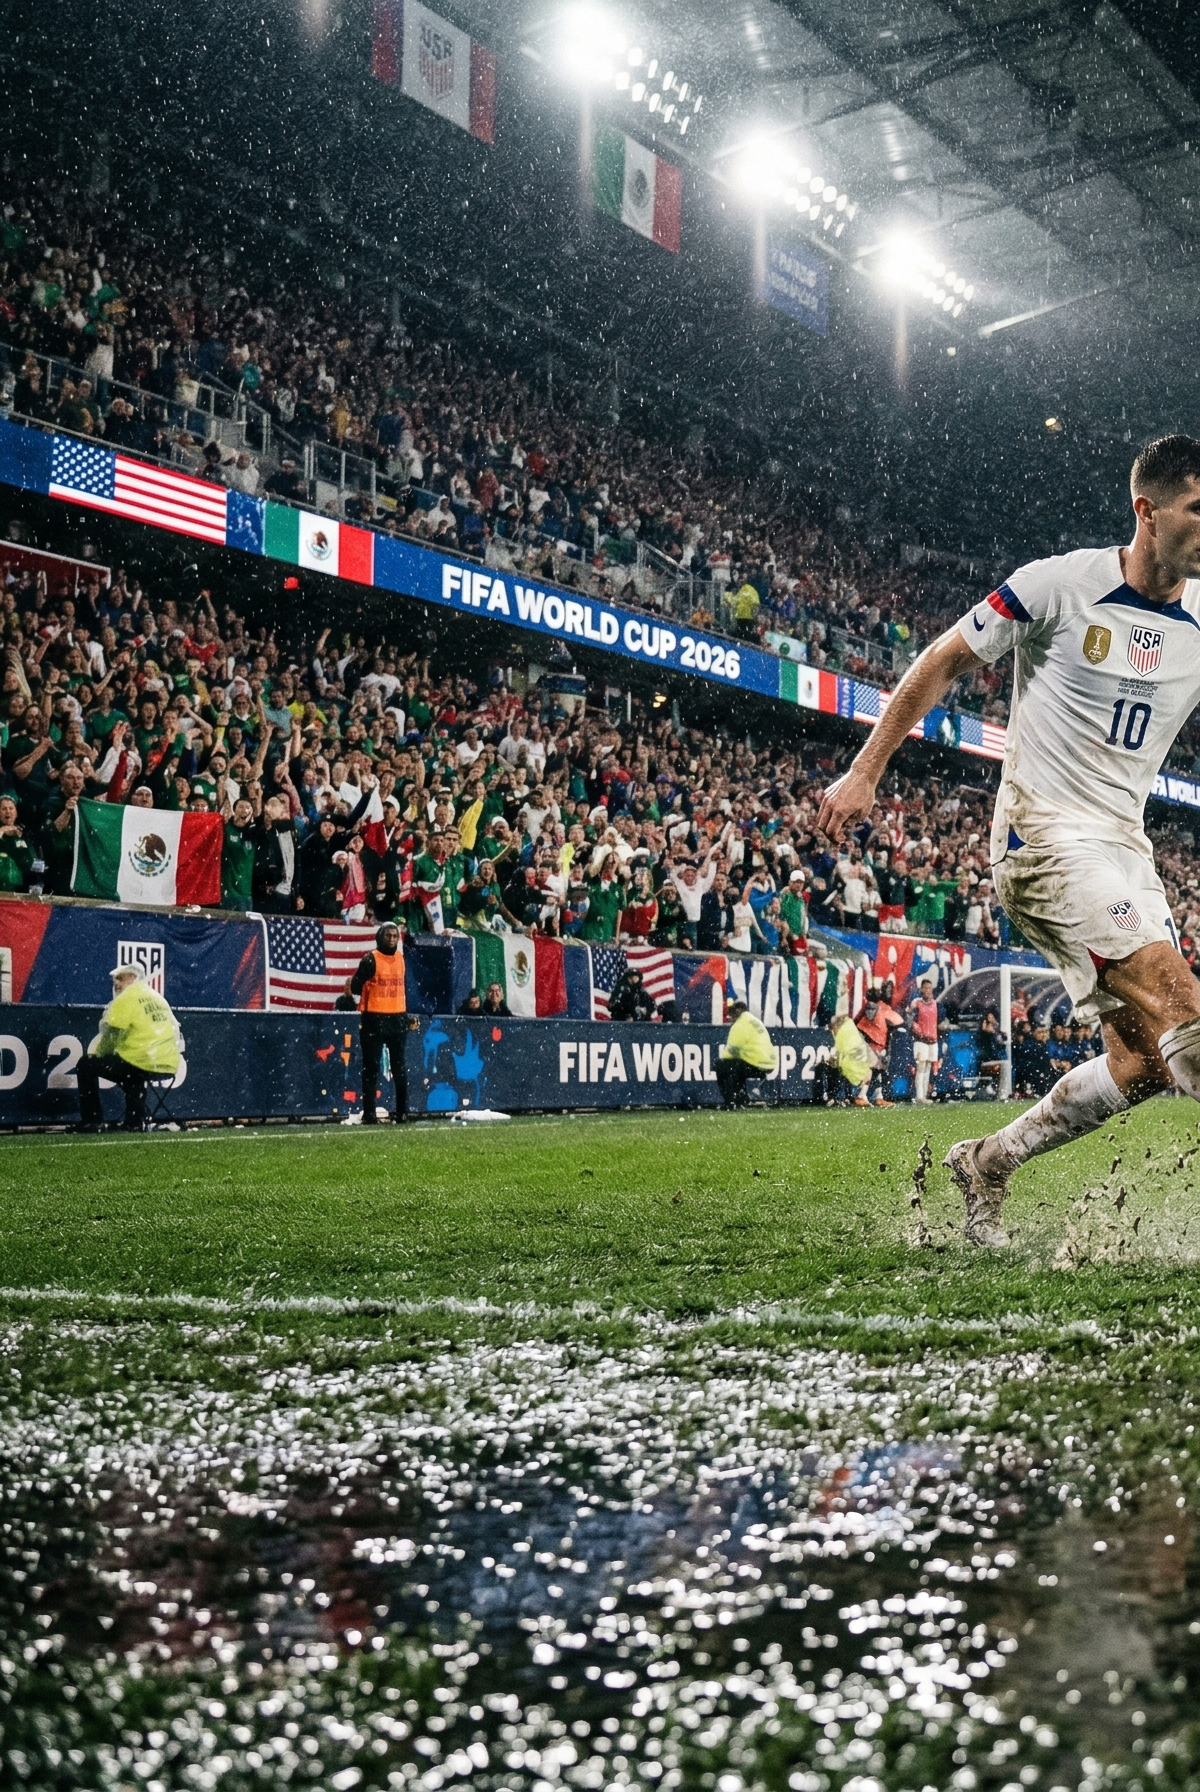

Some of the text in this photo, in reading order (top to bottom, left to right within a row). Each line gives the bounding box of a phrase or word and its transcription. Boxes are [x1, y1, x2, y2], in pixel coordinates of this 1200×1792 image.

[442, 563, 741, 680] FIFA WORLD CUP 2026
[1133, 628, 1161, 650] USA
[1105, 698, 1152, 751] 10
[121, 945, 161, 975] USA
[559, 1041, 628, 1083] FIFA
[632, 1043, 725, 1082] WORL
